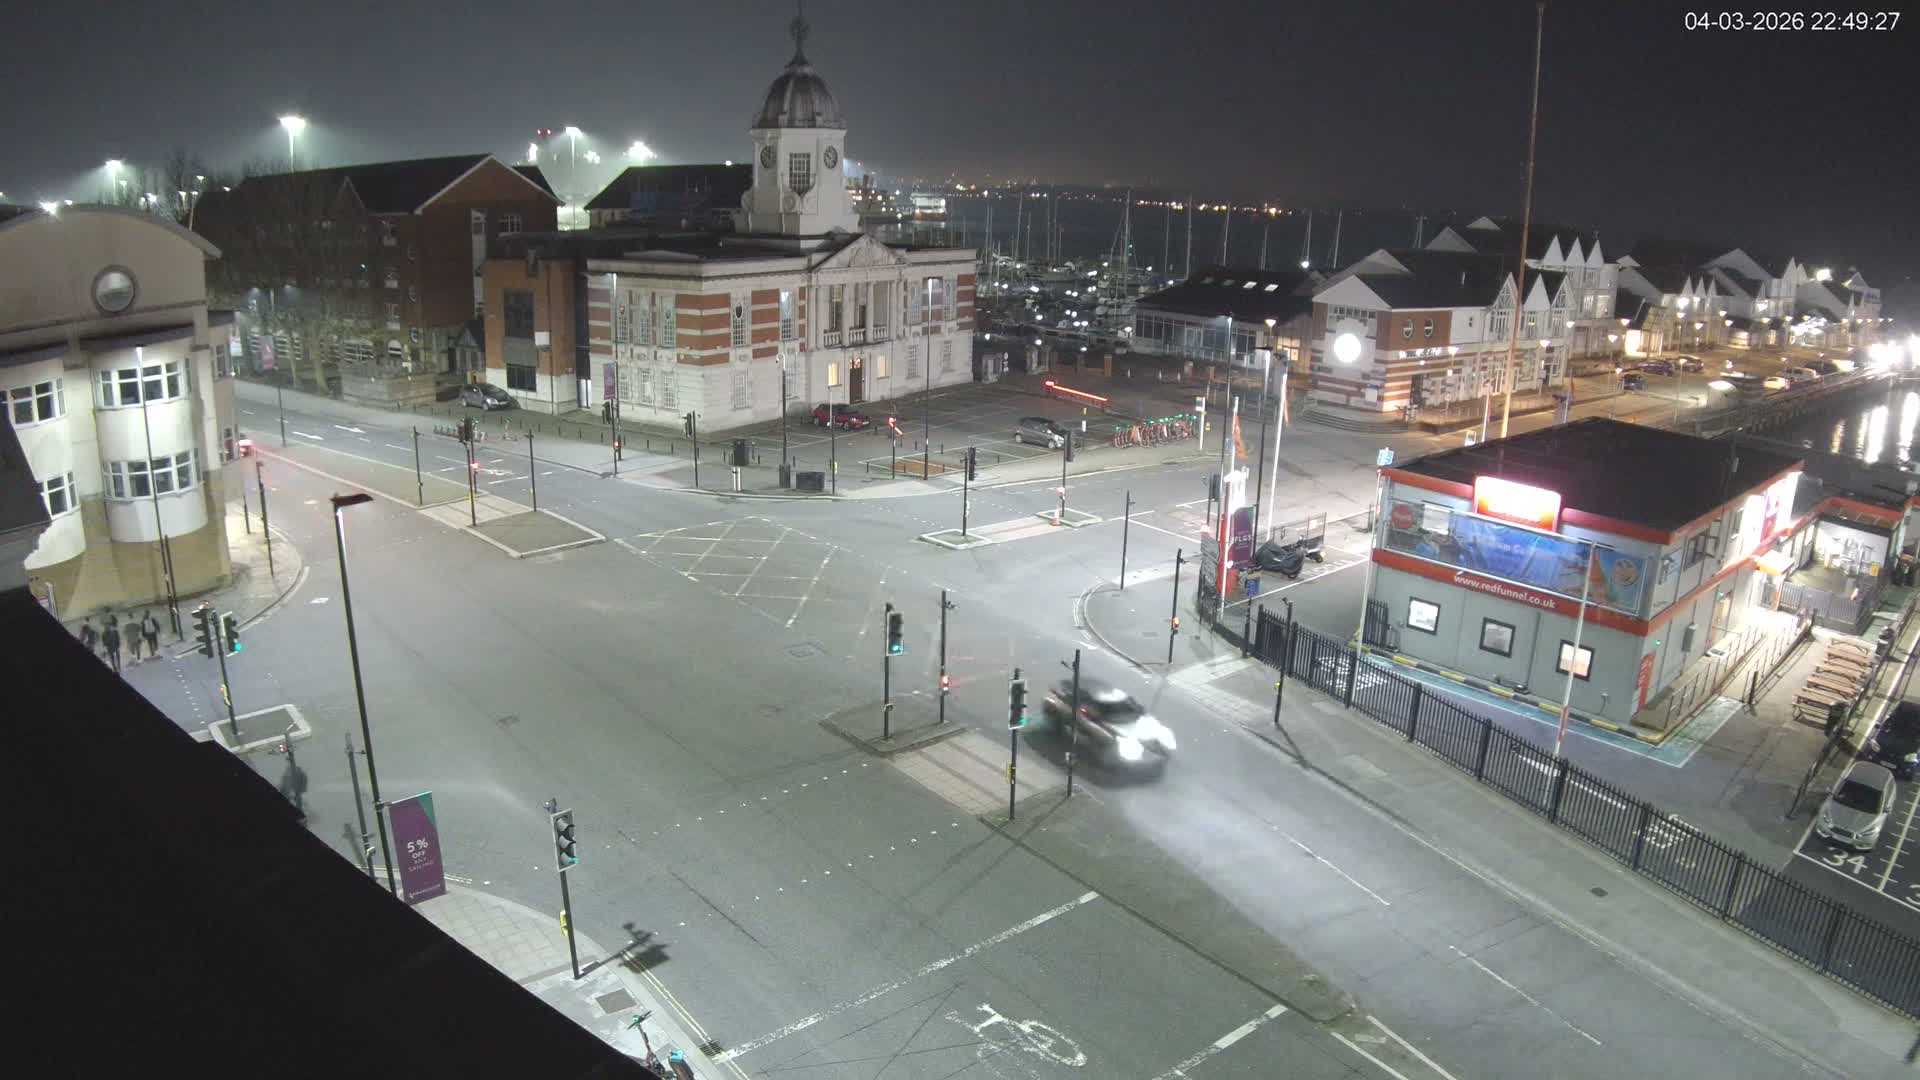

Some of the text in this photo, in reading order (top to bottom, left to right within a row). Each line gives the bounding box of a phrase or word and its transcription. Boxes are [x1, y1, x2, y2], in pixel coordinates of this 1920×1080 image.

[1453, 574, 1557, 609] www.redfunnel.co.uk
[412, 850, 427, 859] OFF
[1822, 846, 1868, 874] 34
